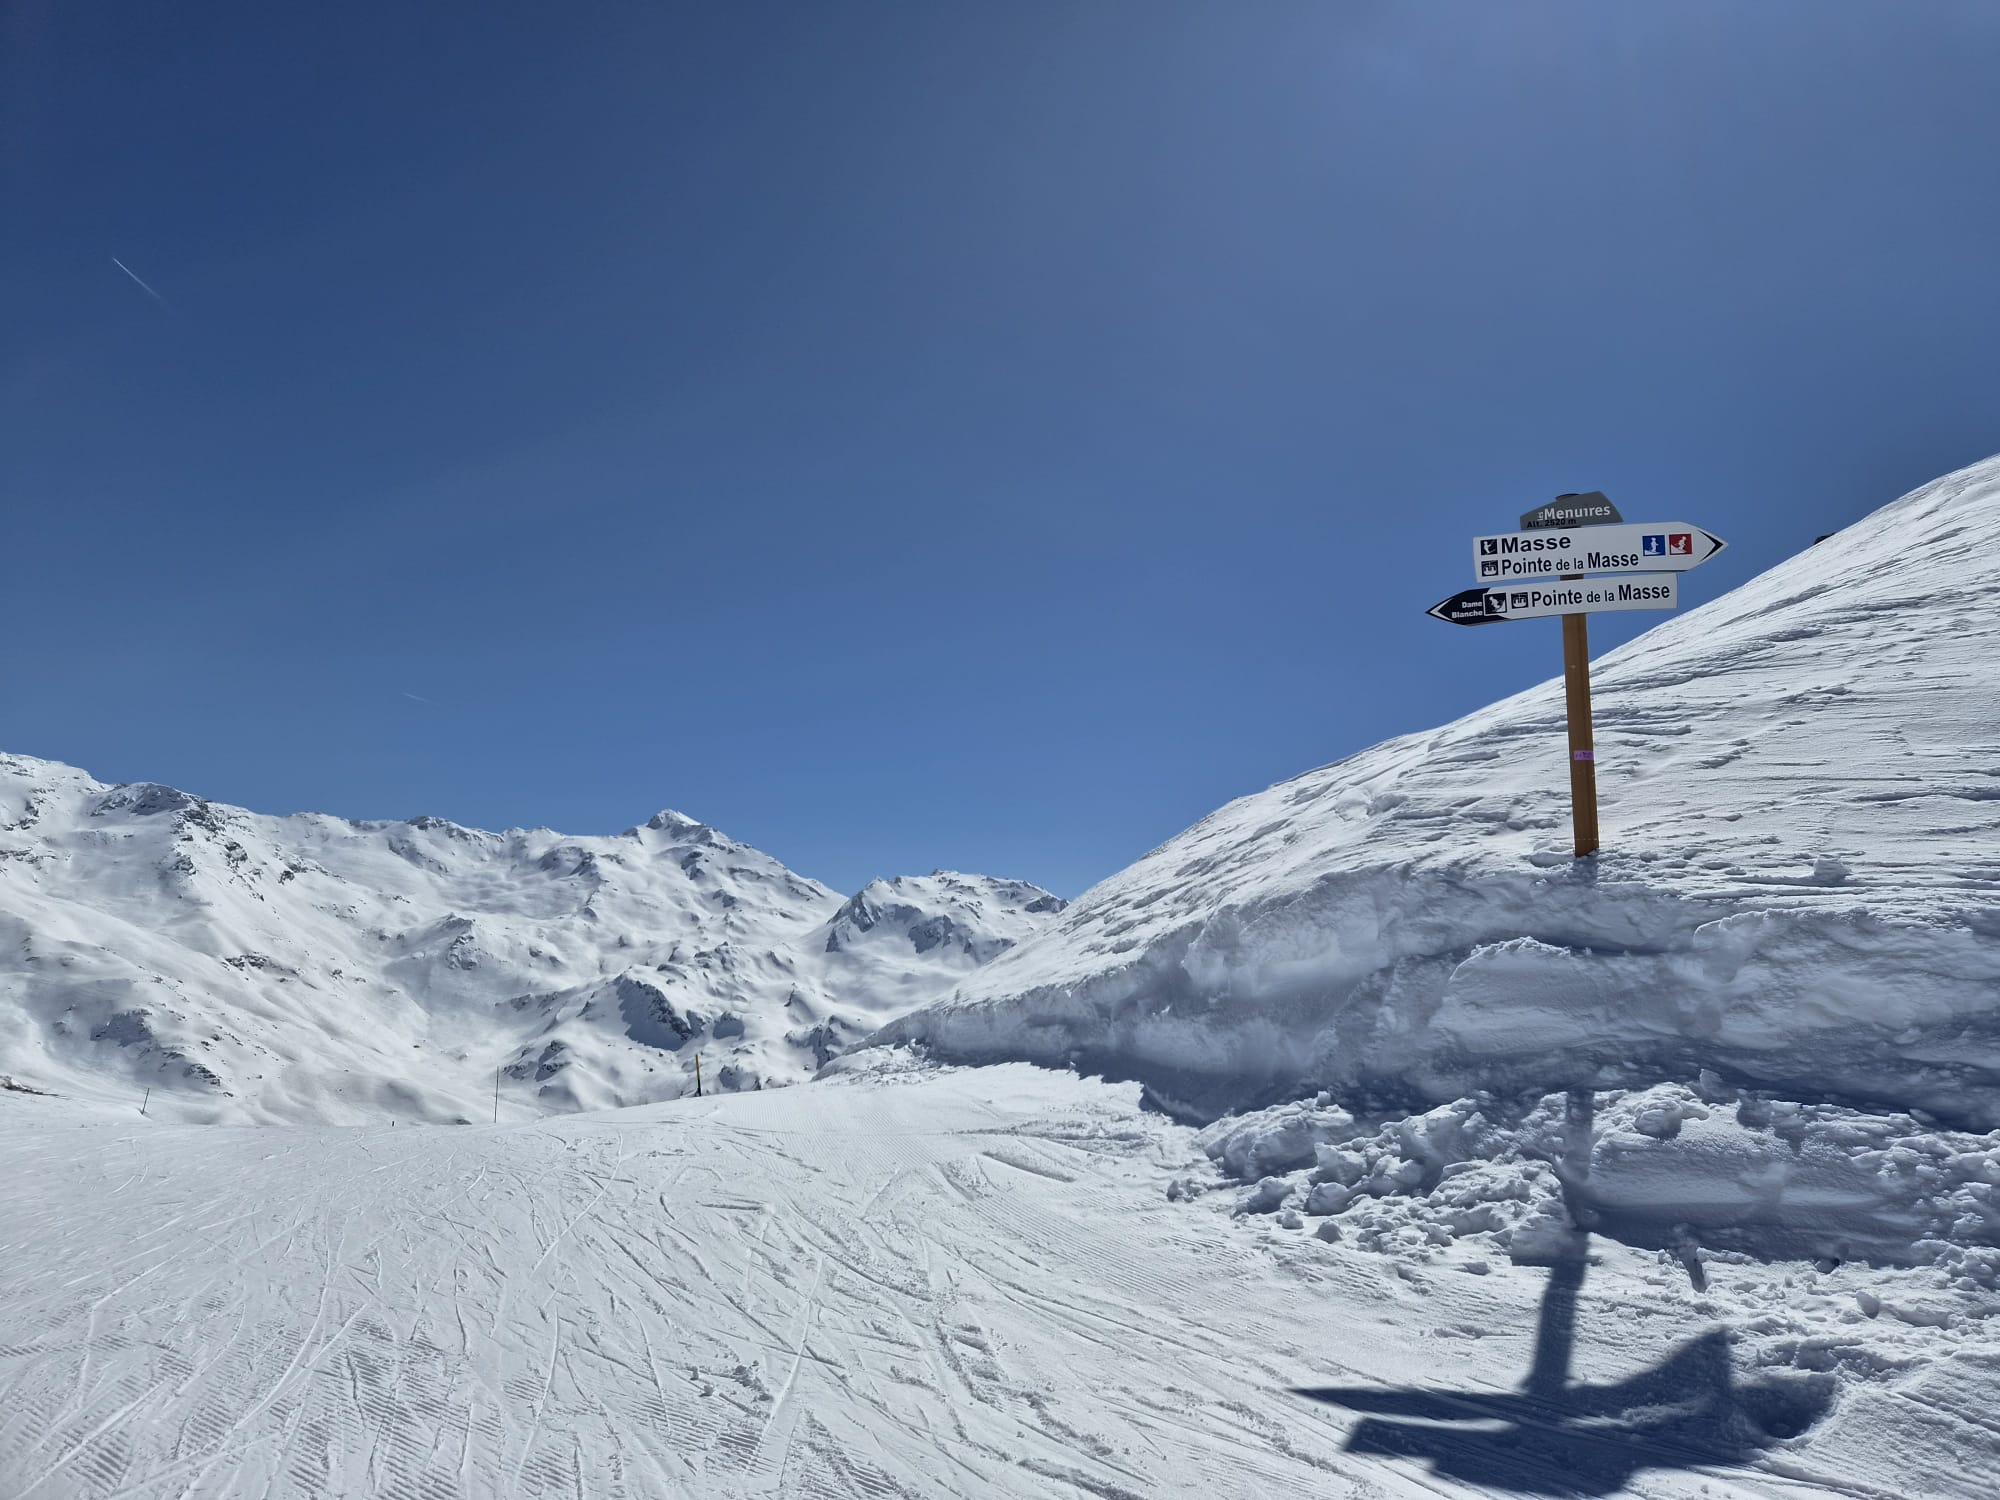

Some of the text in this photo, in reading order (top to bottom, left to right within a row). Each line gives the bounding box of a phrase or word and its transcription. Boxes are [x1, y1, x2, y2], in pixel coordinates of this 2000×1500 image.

[1544, 505, 1611, 520] Menuires
[1527, 520, 1543, 529] Alt.
[1544, 518, 1566, 527] 2520
[1501, 536, 1571, 554] Masse
[1502, 551, 1639, 575] Pointe de la Masse
[1531, 584, 1670, 608] Pointe de la Masse
[1461, 601, 1483, 609] Dame
[1451, 610, 1483, 619] Blanche
